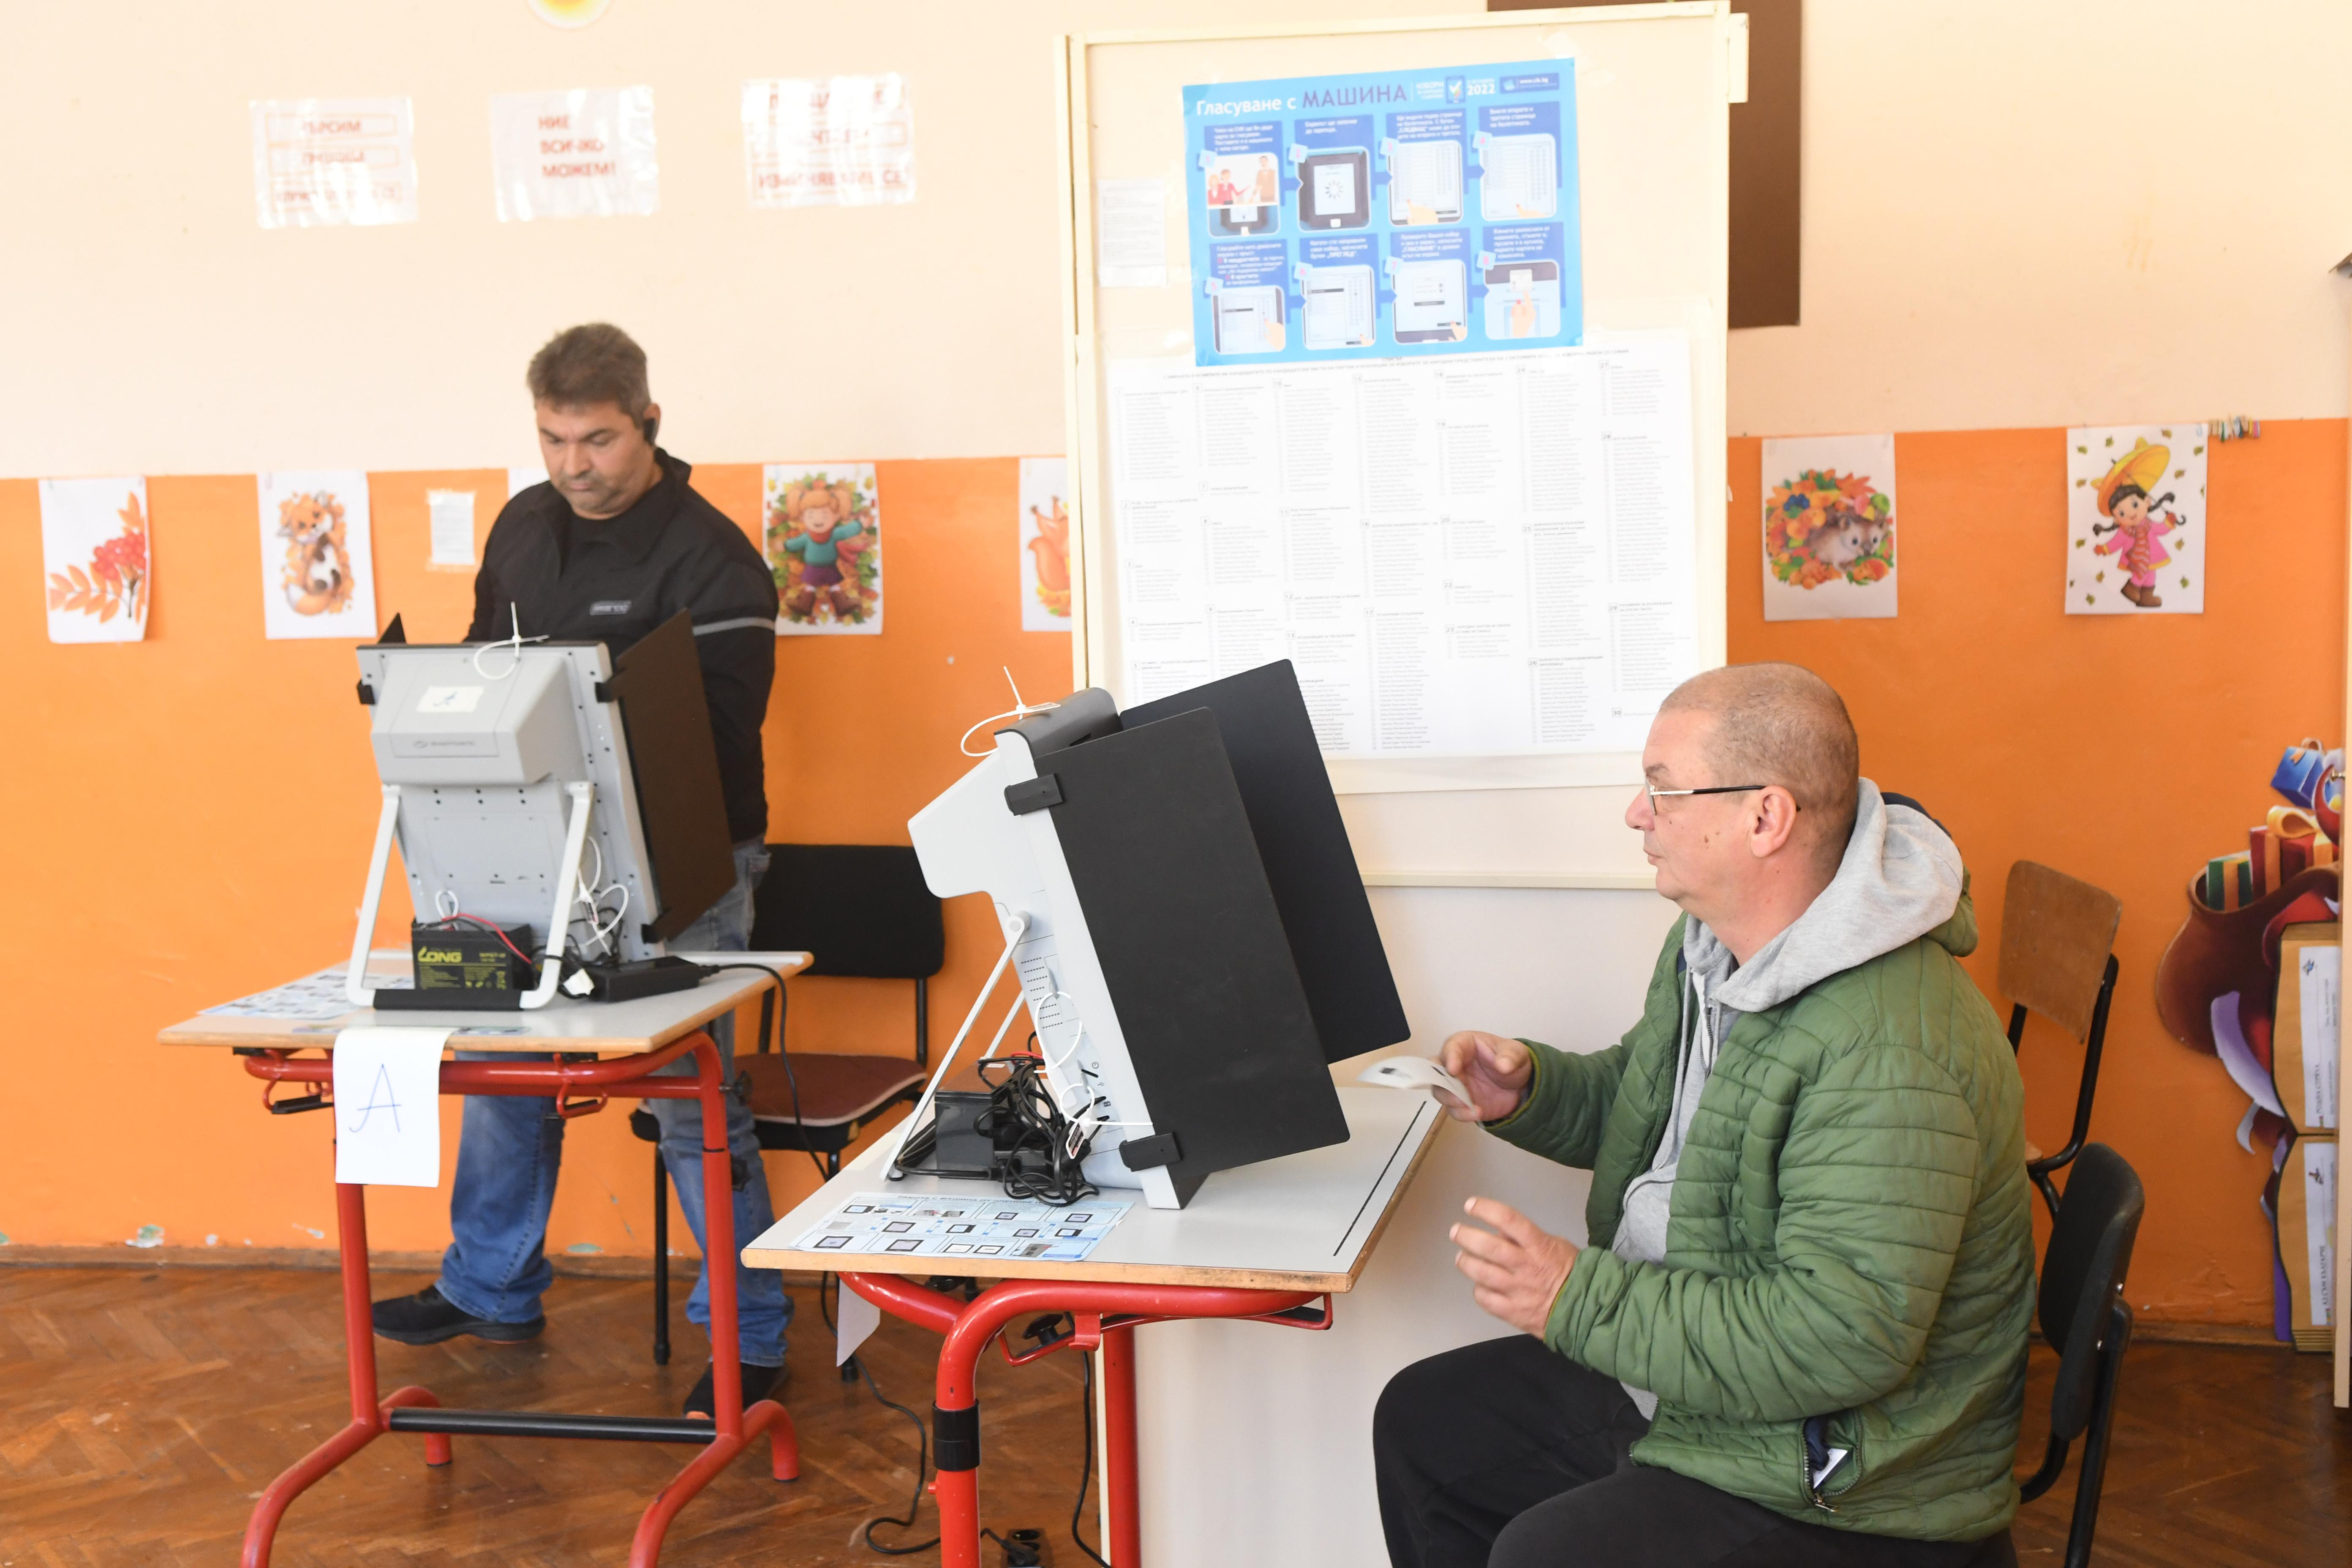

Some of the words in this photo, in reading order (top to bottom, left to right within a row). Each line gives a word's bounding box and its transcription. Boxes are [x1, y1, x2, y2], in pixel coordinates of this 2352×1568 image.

[1467, 83, 1496, 96] 2022
[1197, 98, 1281, 117] Гласуване
[1288, 98, 1296, 109] с
[1302, 84, 1407, 108] МАШИНА
[538, 114, 570, 130] НИЕ
[540, 138, 605, 155] ВСИЧКО
[1480, 136, 1486, 145] 4
[542, 161, 615, 178] МОЖЕМ!
[1393, 262, 1398, 270] 7
[417, 946, 462, 963] LONG
